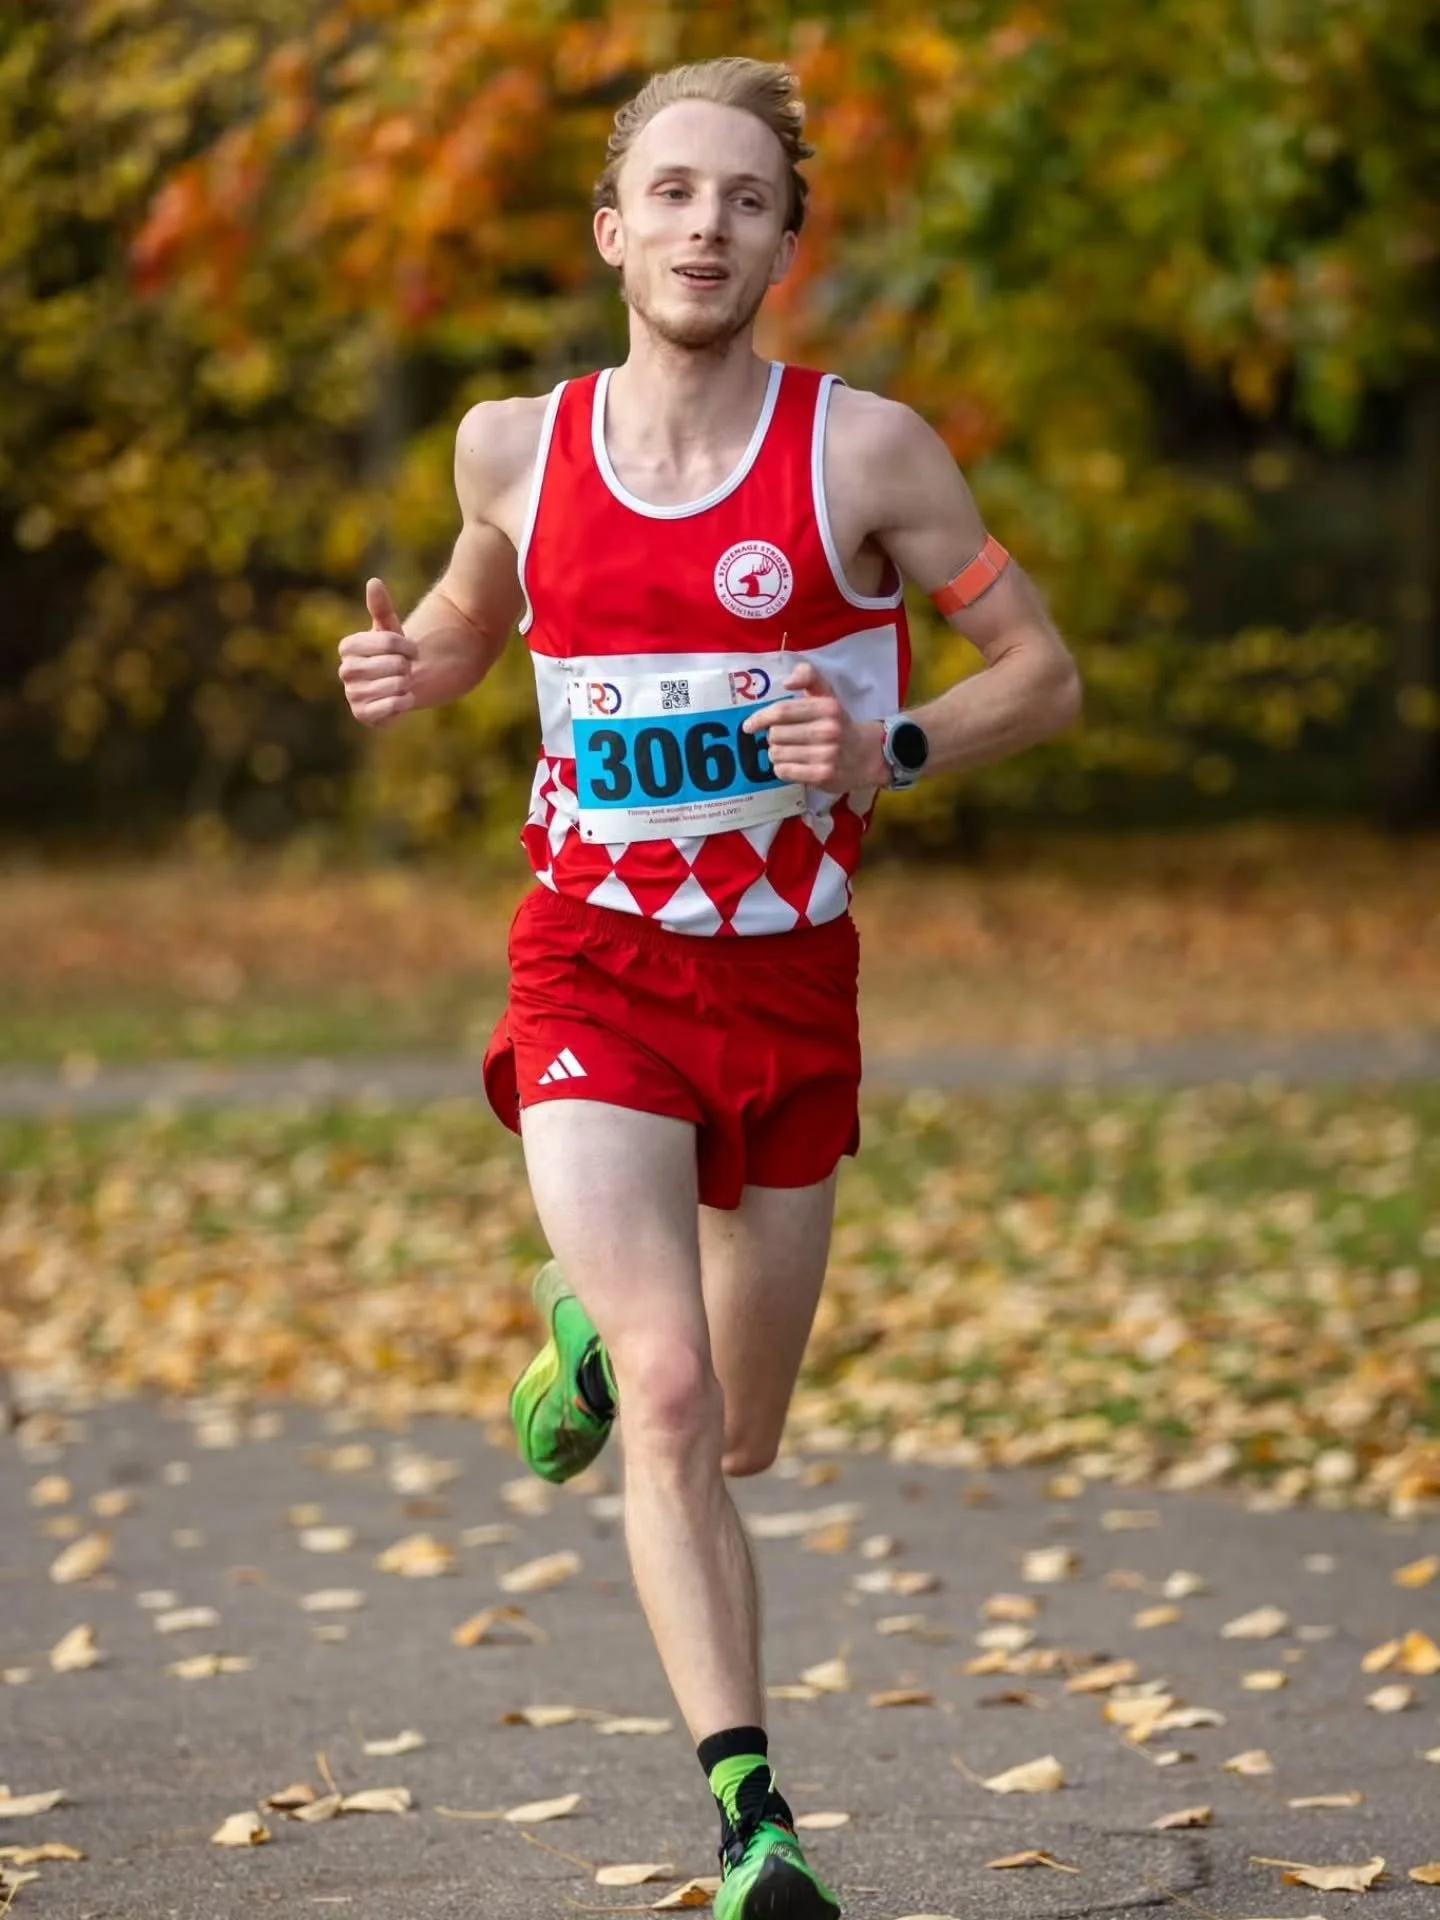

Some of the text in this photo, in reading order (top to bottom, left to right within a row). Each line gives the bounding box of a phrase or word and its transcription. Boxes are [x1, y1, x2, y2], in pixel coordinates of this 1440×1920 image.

[718, 544, 789, 579] STEVENAGE STRIDERS
[720, 593, 787, 617] RUNNING CLUB
